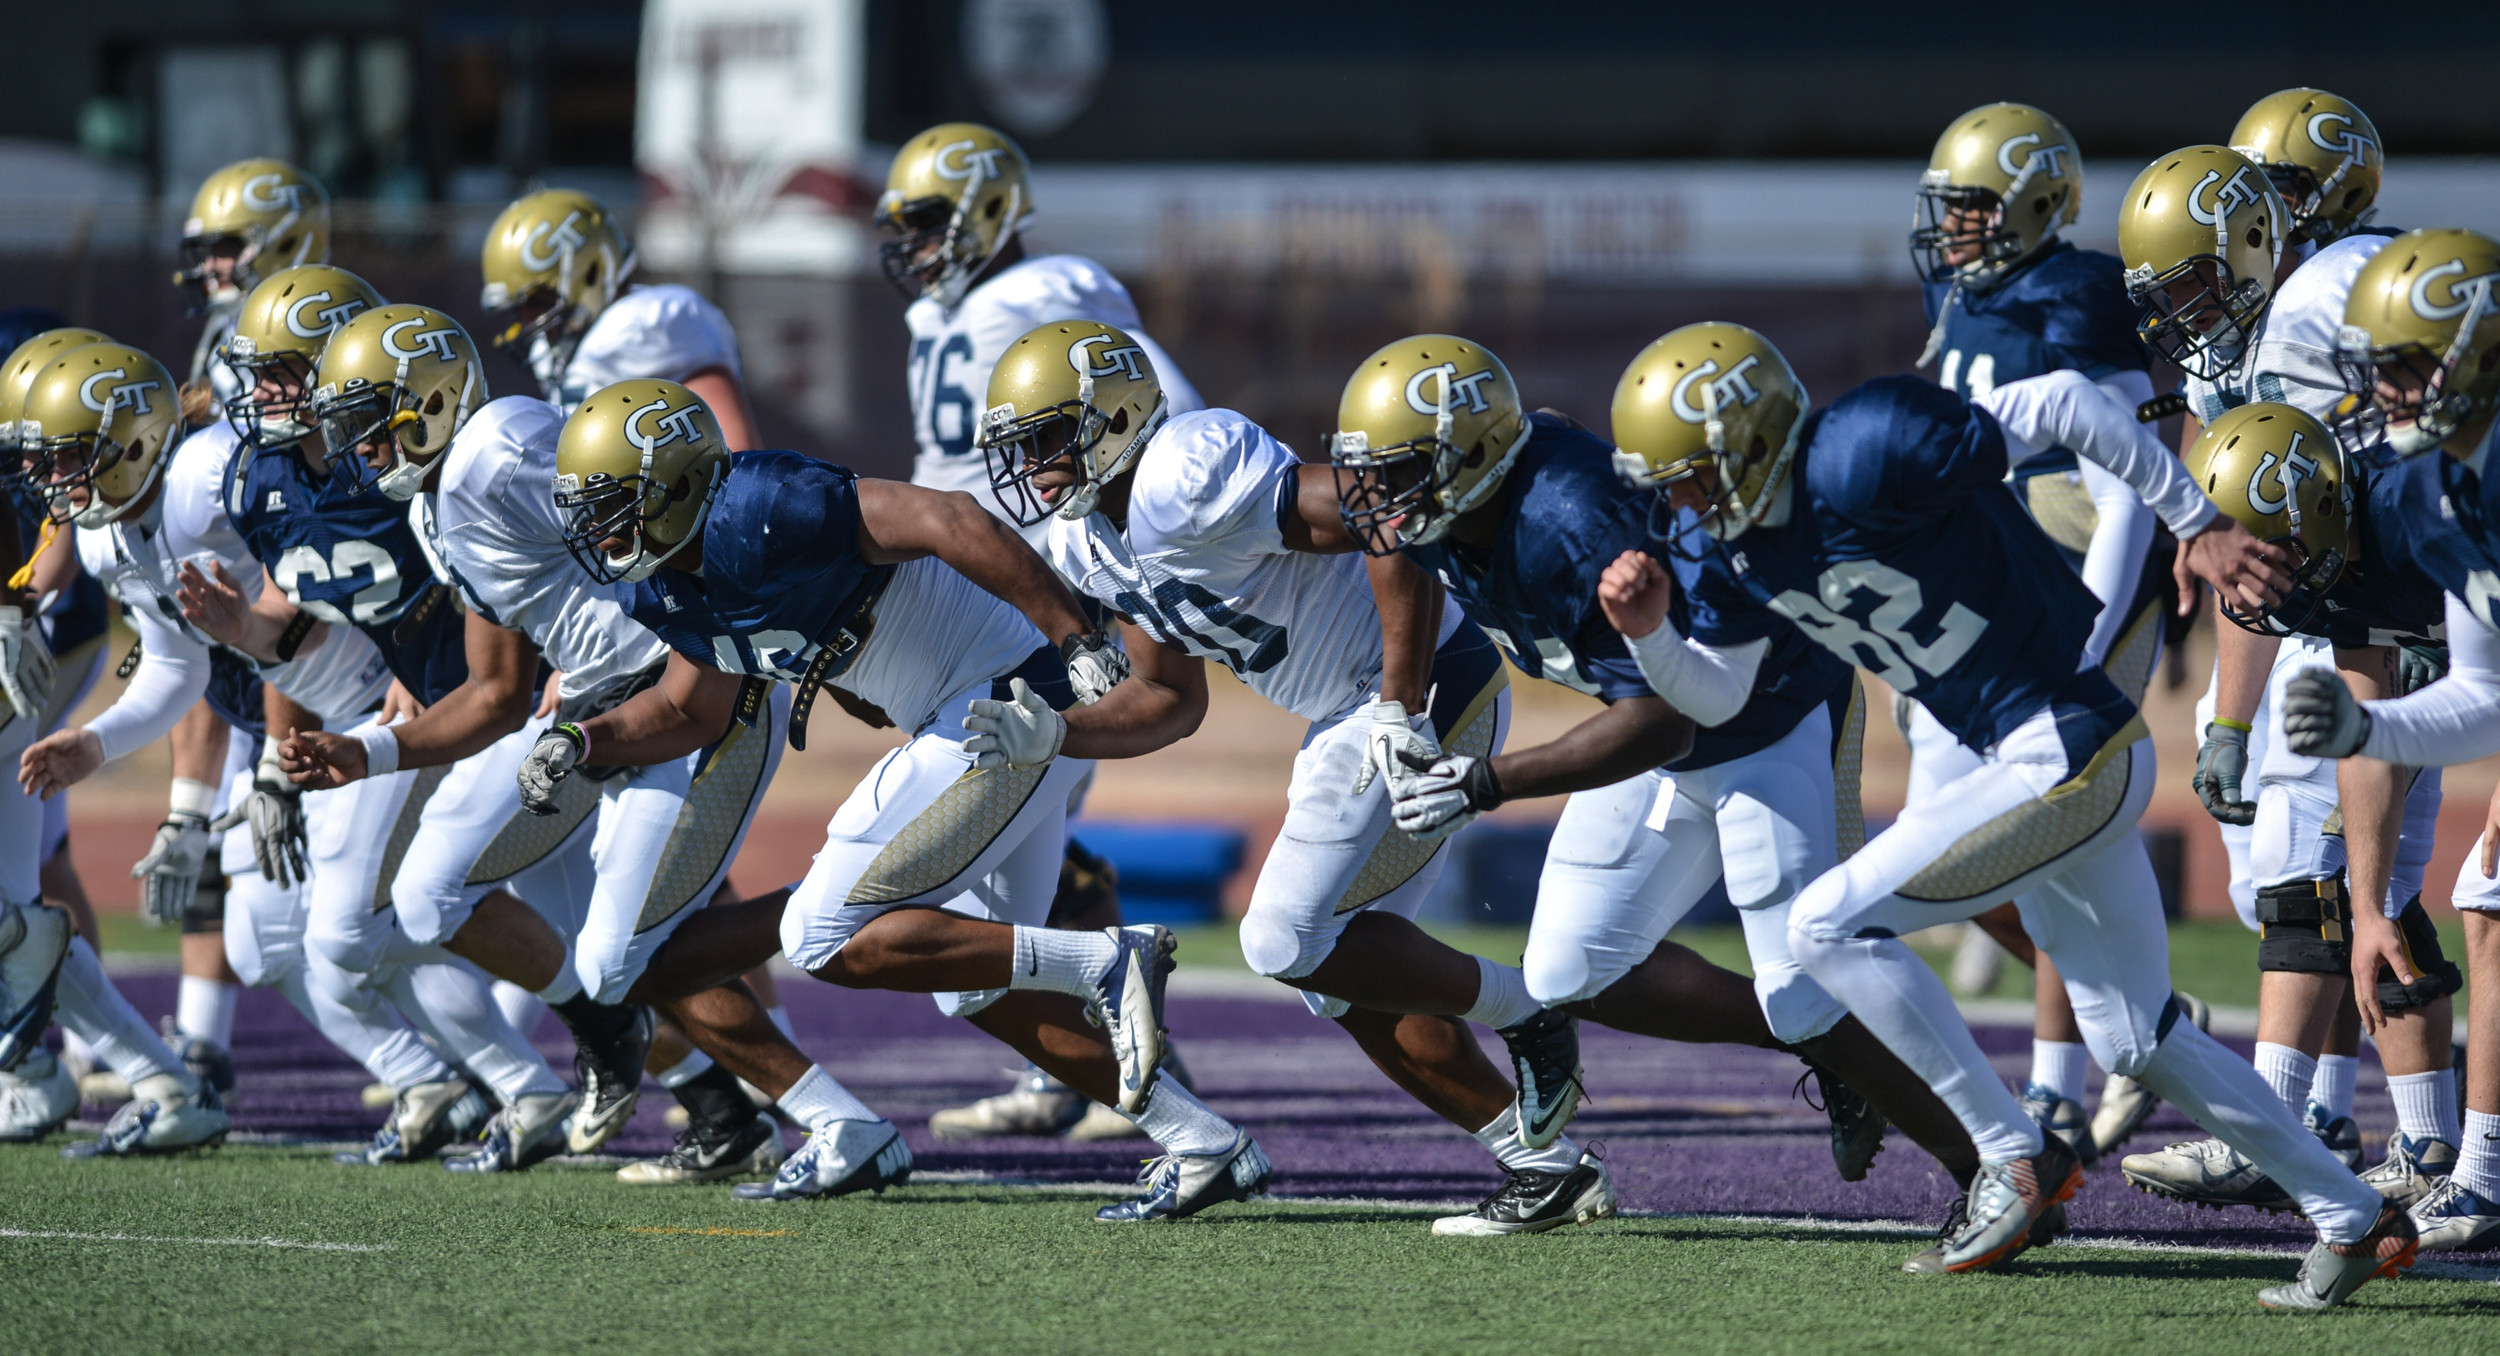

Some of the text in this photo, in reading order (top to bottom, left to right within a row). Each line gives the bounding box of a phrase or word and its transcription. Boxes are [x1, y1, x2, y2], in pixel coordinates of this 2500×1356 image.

[934, 140, 1006, 182] GT
[1997, 132, 2066, 178] GT
[2306, 112, 2377, 167] GT
[2186, 164, 2261, 227] GT
[380, 316, 461, 363] GT
[1067, 333, 1145, 382] GT
[79, 367, 160, 416] GT
[911, 330, 975, 457] 76
[1403, 361, 1495, 416] GT
[1670, 353, 1763, 424] GT
[623, 398, 705, 446] GT
[2247, 430, 2321, 516] GT
[1114, 576, 1290, 684] 0
[1766, 558, 1990, 693] 82
